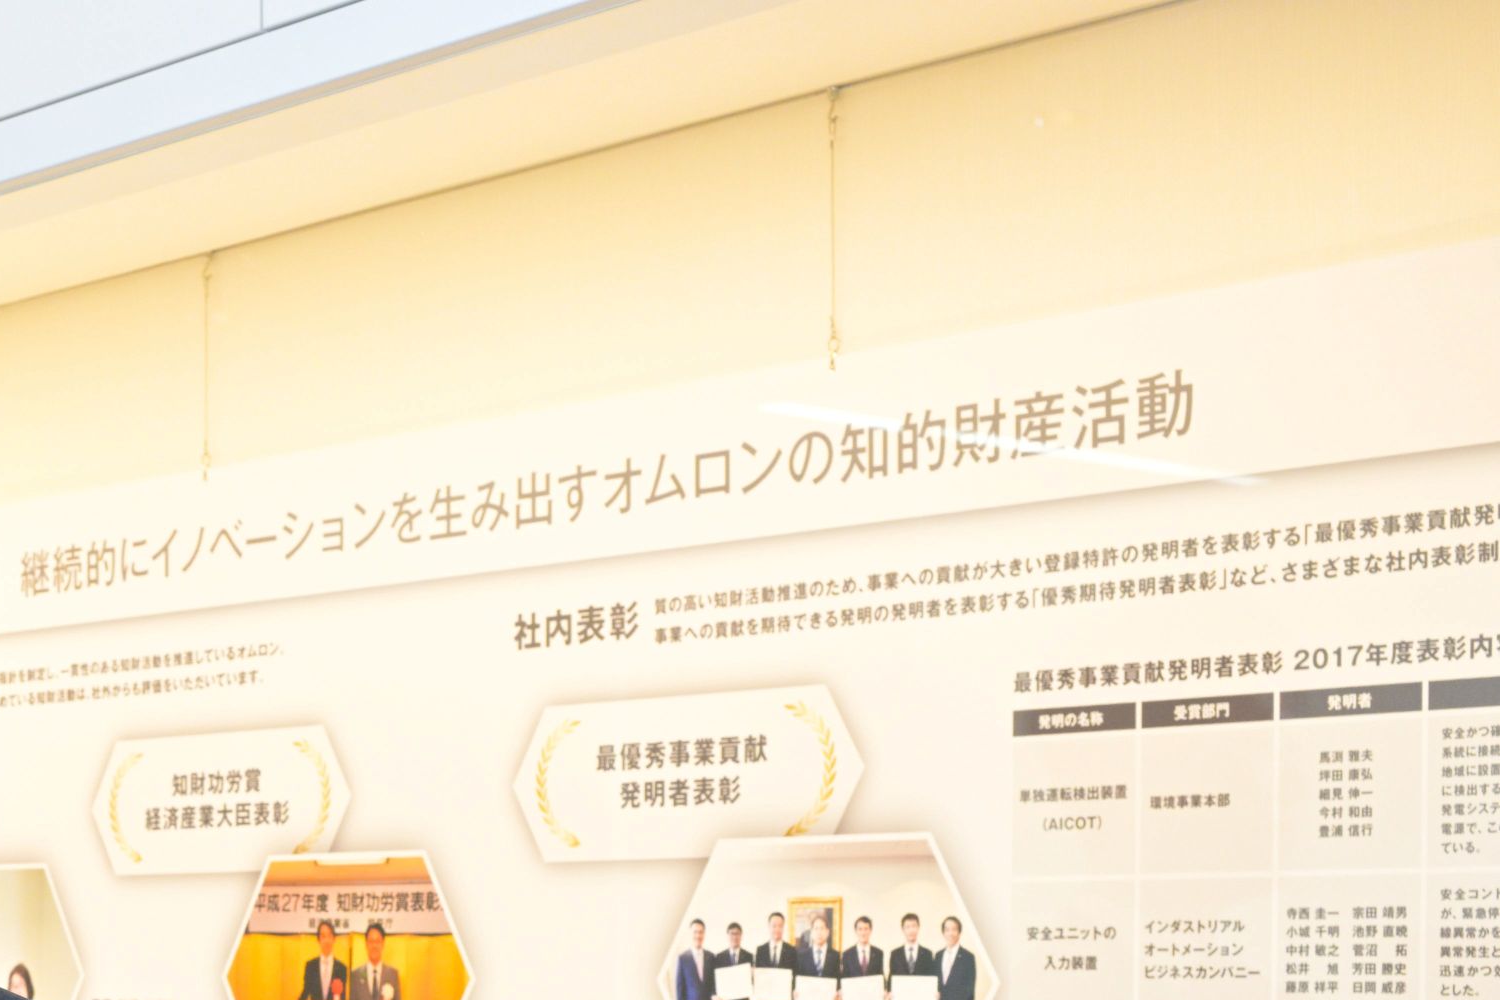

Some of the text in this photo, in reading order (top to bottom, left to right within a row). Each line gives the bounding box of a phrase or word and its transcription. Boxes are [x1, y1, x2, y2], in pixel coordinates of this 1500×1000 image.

[20, 369, 1195, 597] 継続的にイノベーションを生み出すオムロンの知的財産活動
[655, 503, 1500, 615] 質の高い知財活動推進のため、事業への貢献が大きい登録特許の発明者を表彰する「最優秀事業貢献発
[514, 602, 638, 650] 社内表彰
[1014, 634, 1500, 693] 最優秀事業貢献発明者表彰 2017年度表彰内
[1327, 694, 1371, 709] 発明者
[1039, 711, 1103, 729] 発明の名称
[1174, 703, 1230, 721] 受賞部門
[597, 734, 767, 771] 最優秀事業貢献
[172, 769, 261, 797] 知財功労賞
[620, 776, 740, 809] 発明者表彰
[1020, 784, 1127, 804] 単独運転検出装置
[1150, 793, 1231, 809] 環境事業本部
[145, 800, 289, 831] 経済産業大臣表彰
[1319, 806, 1343, 819] 今村
[1042, 816, 1101, 831] (AICOT)
[1441, 822, 1500, 835] 電源で、こ
[1027, 926, 1116, 941] 安全ユニットの
[1144, 920, 1245, 934] インダストリアル
[1144, 942, 1243, 957] オートメーション
[1286, 943, 1309, 957] 中村
[1044, 955, 1097, 970] 入力装置
[1144, 965, 1261, 979] ビジネスカンパニー
